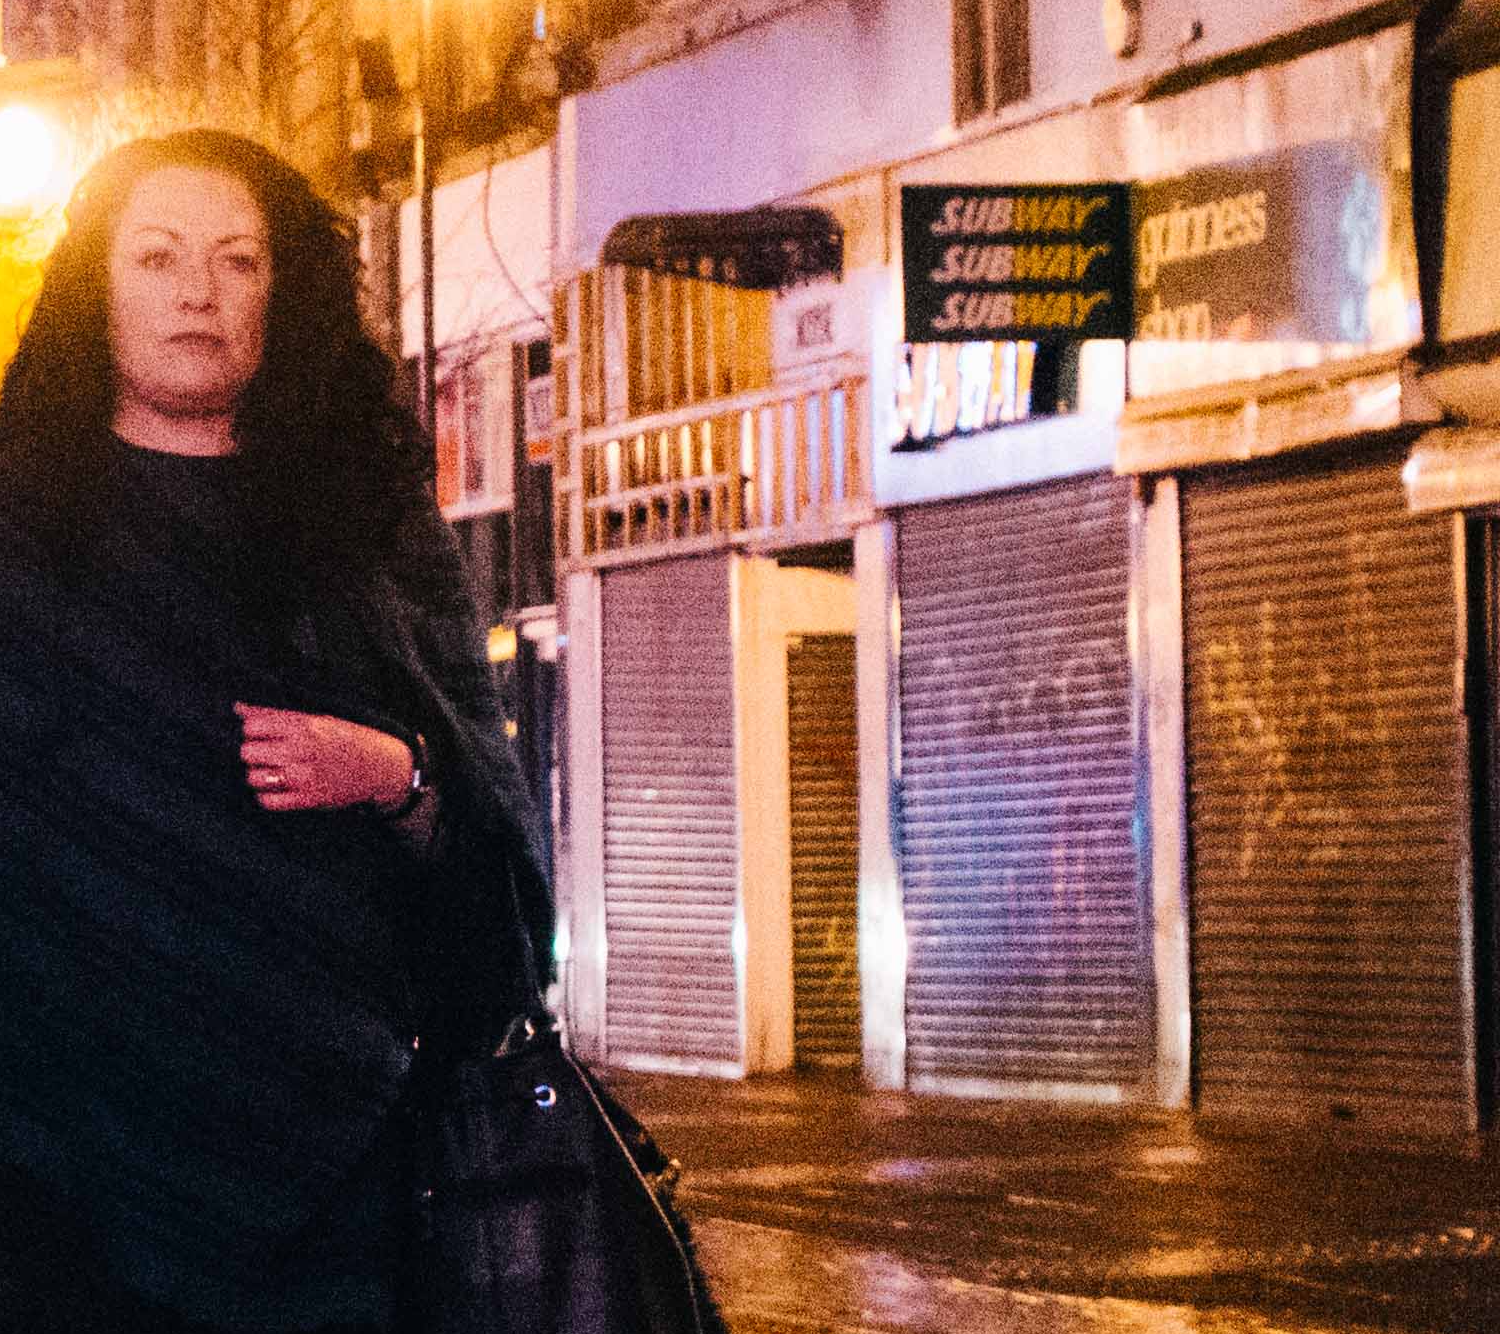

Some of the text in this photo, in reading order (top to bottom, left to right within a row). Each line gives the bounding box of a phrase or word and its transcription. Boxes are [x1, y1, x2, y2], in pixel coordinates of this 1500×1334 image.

[930, 195, 1110, 235] SUBWAY
[929, 241, 1111, 283] SUBWAY
[930, 288, 1111, 332] SUBWAY
